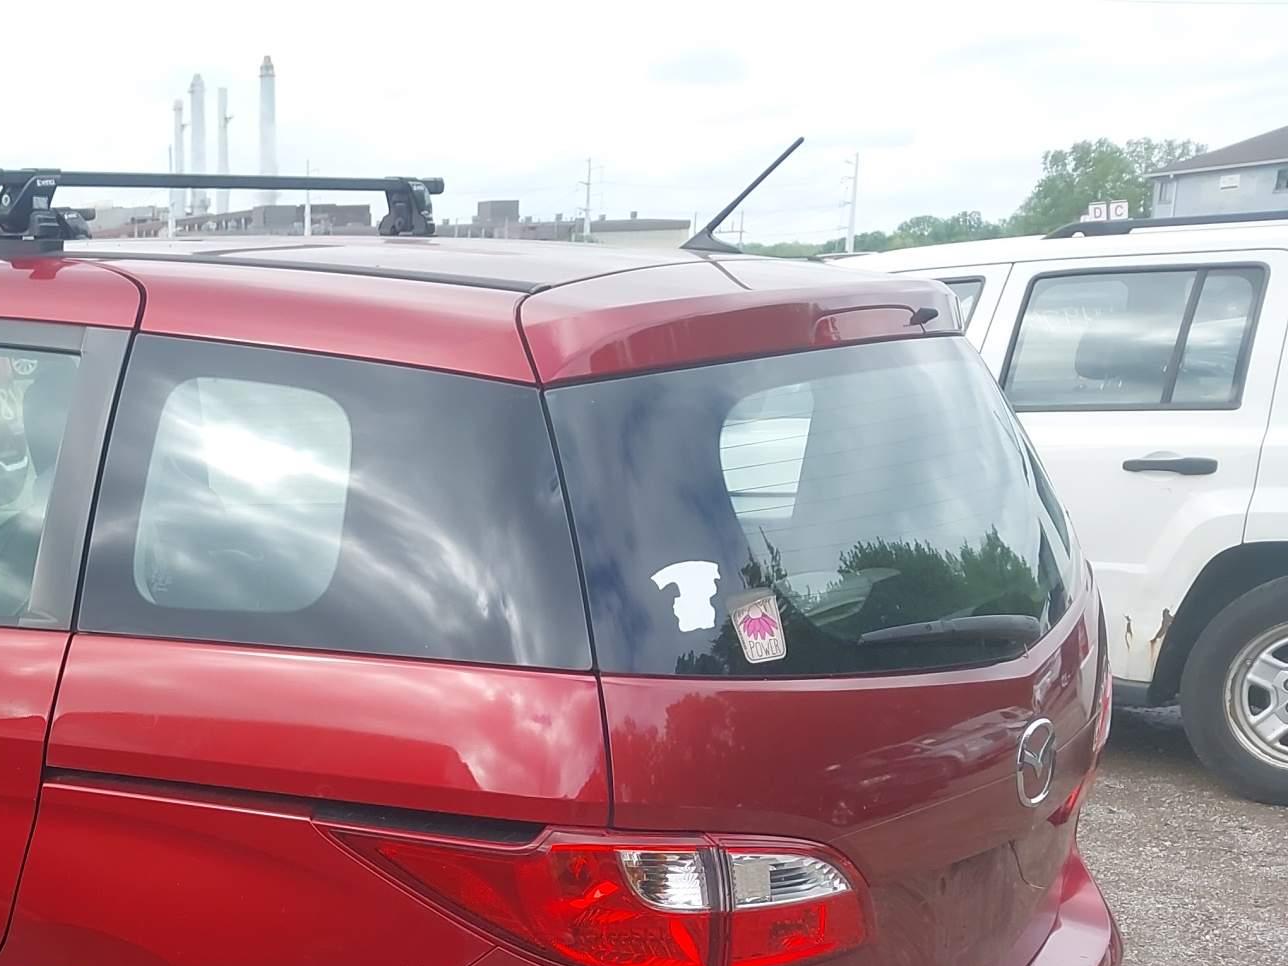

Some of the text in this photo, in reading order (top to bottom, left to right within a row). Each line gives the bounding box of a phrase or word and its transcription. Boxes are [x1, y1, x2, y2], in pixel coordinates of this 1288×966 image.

[1093, 206, 1103, 219] D
[1114, 204, 1124, 217] C
[748, 638, 782, 658] POWER
